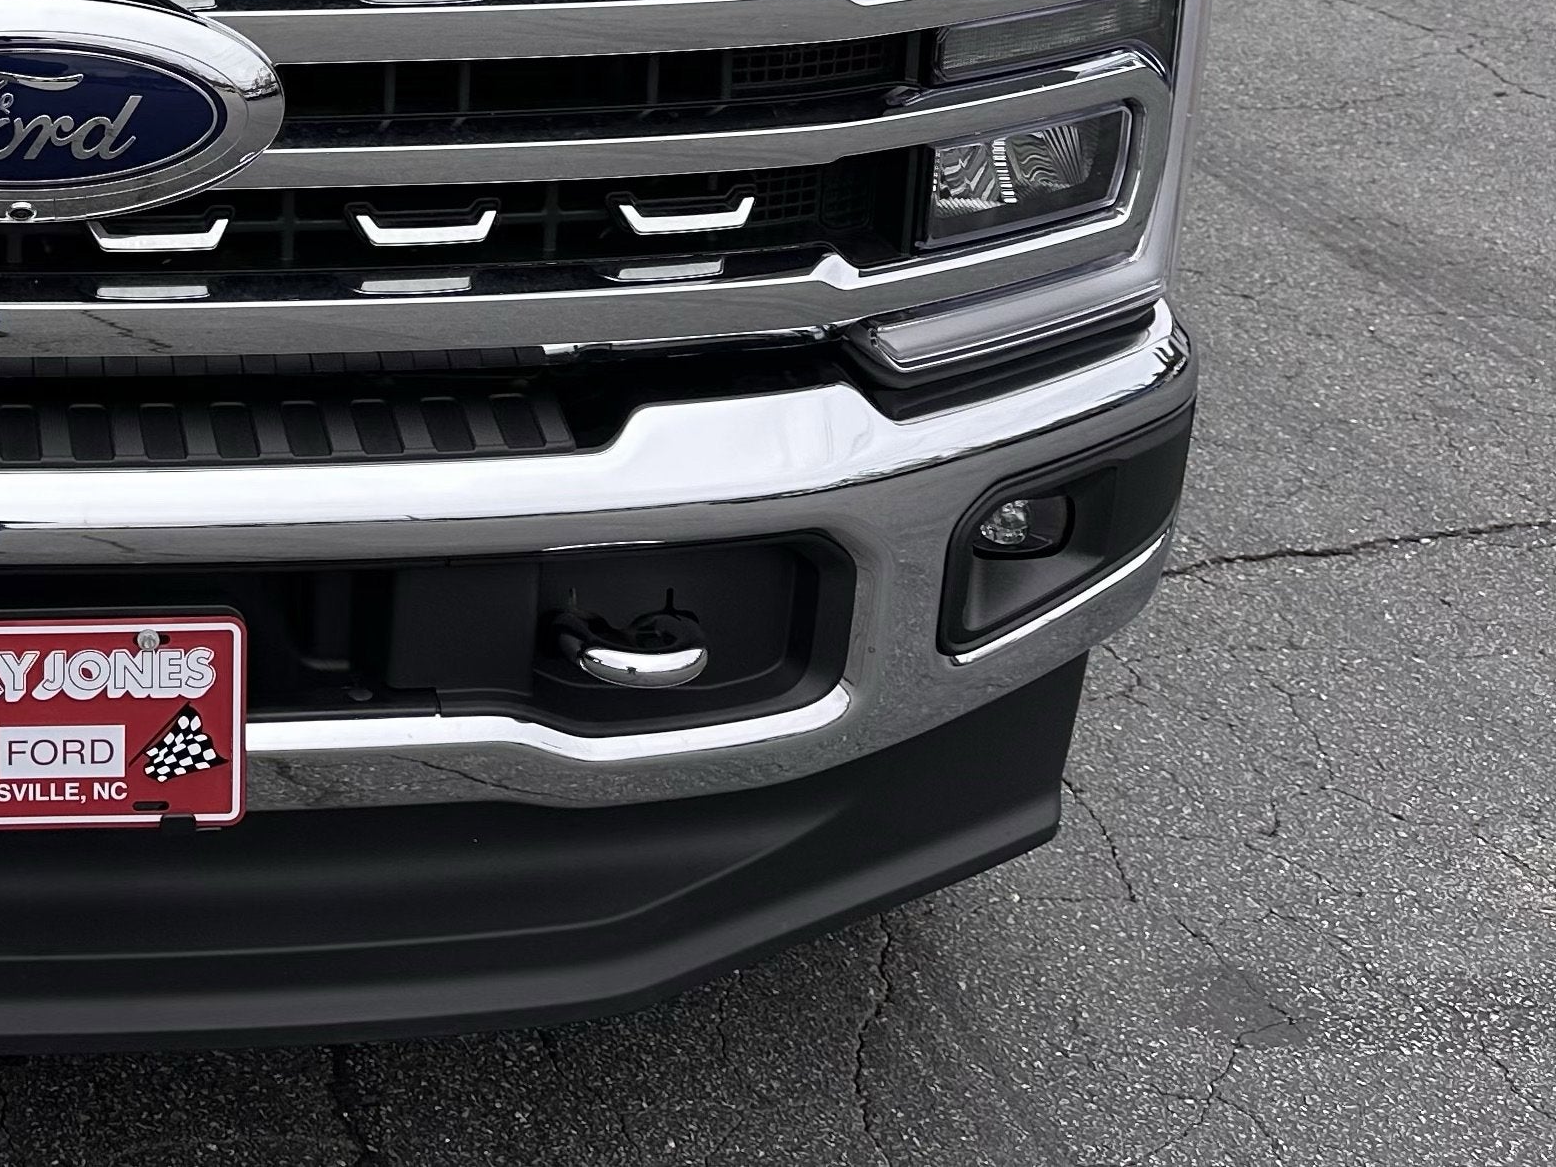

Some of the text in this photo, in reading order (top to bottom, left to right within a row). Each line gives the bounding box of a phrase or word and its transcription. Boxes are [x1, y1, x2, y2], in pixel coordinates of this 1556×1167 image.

[32, 646, 217, 702] JONES
[7, 739, 115, 766] FORD
[93, 782, 128, 801] NC
